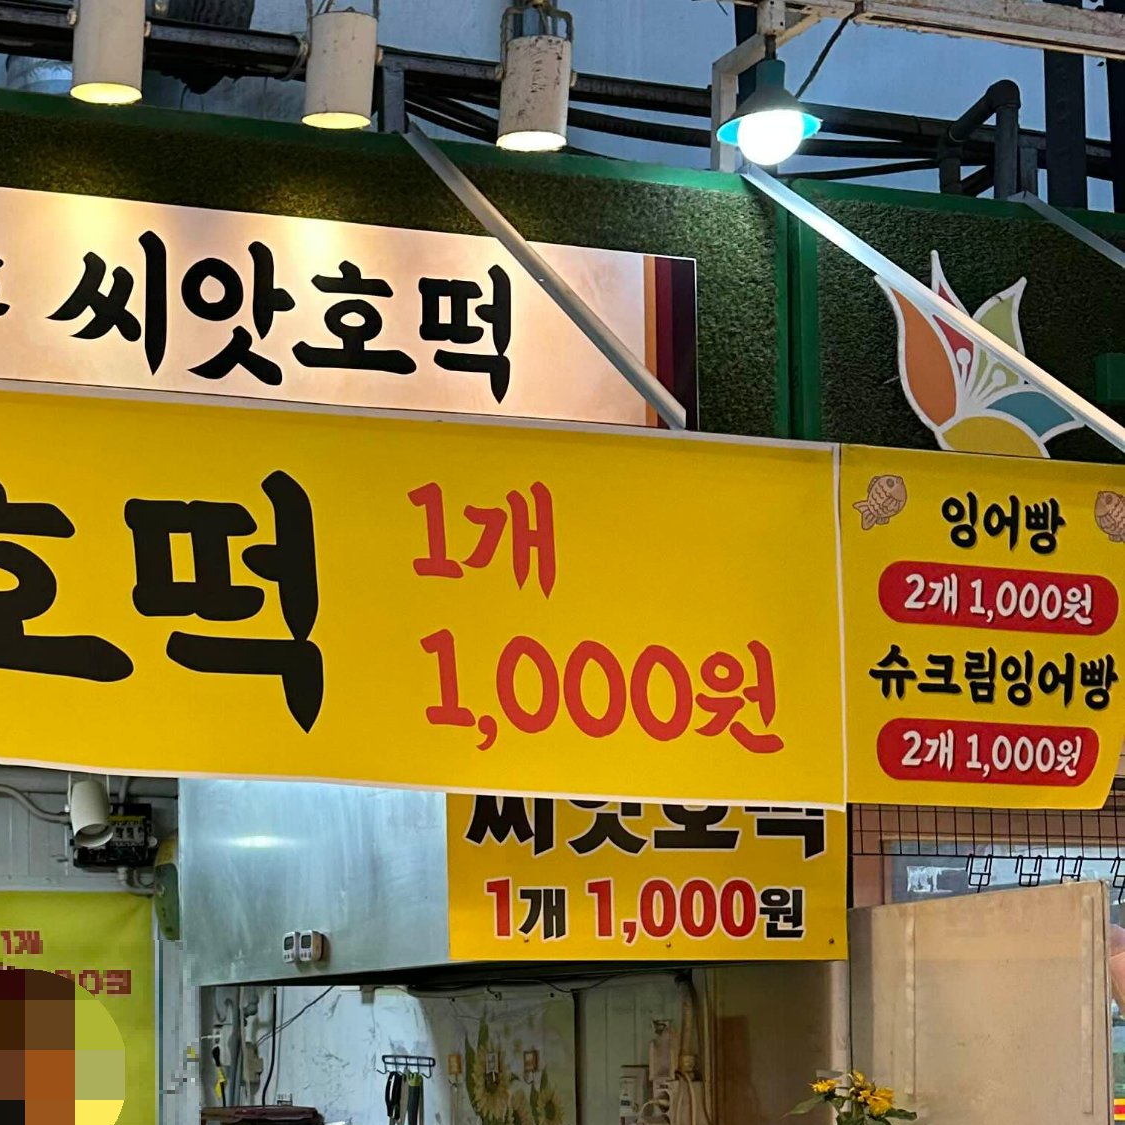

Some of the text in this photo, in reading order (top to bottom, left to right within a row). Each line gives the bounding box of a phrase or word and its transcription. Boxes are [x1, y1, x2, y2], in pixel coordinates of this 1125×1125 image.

[46, 230, 512, 405] 씨앗호떡
[407, 481, 556, 599] 1개
[941, 491, 1065, 554] 잉어빵
[904, 572, 1093, 625] 2개 1,000원
[420, 628, 784, 753] 1,000원
[869, 644, 1118, 710] 슈크림잉어빵
[901, 729, 1083, 777] 2개 1,000원
[485, 877, 805, 944] 1개 1,000원
